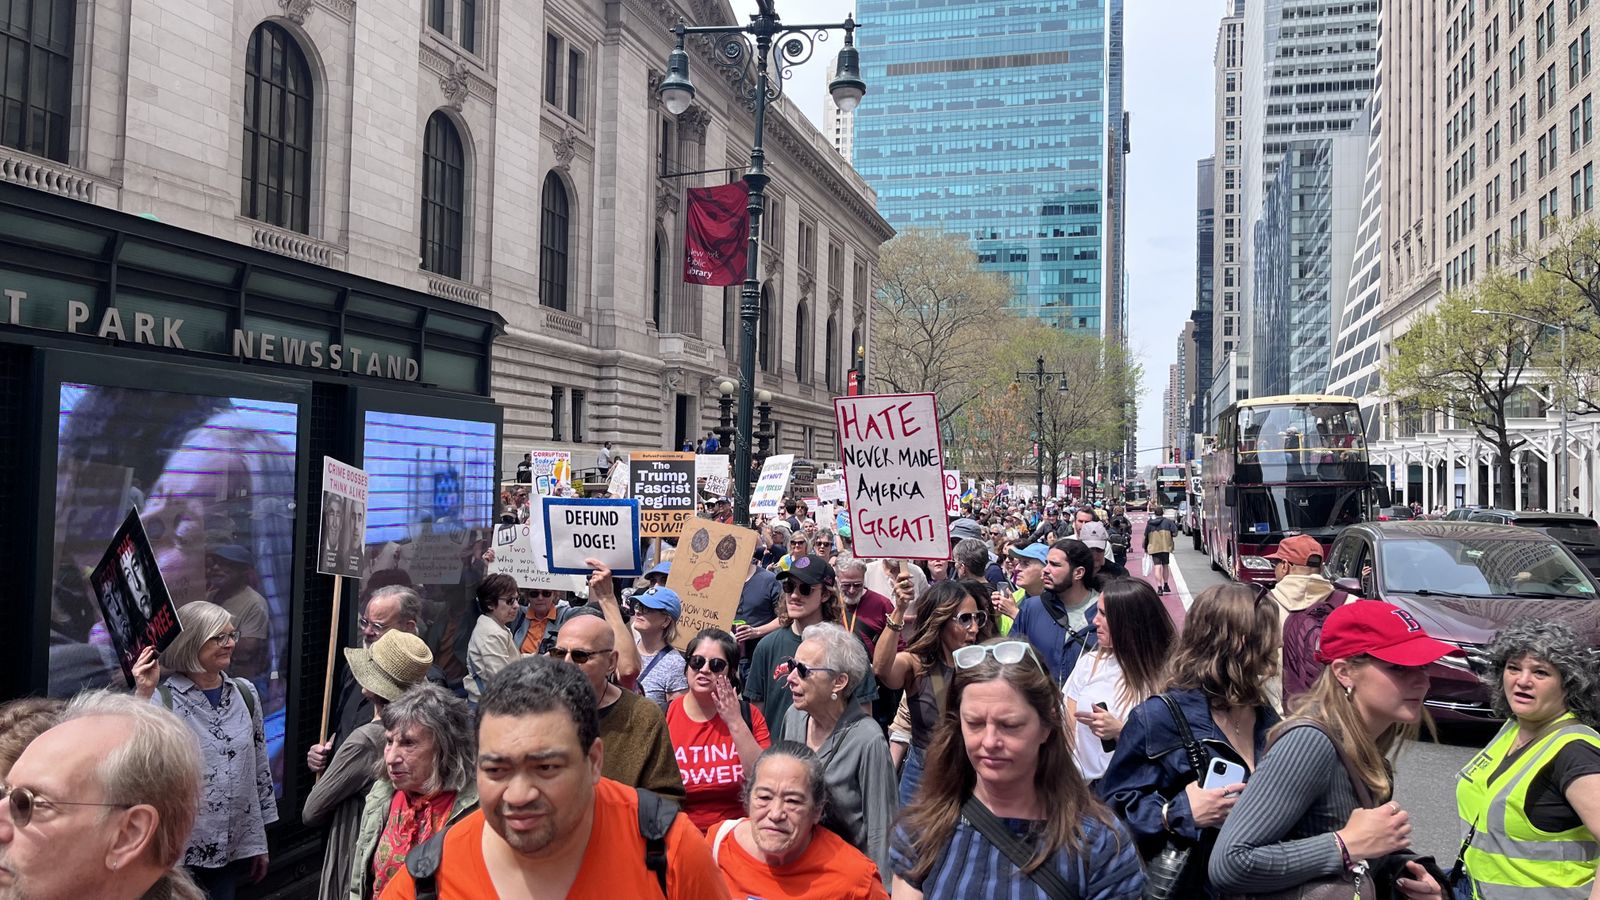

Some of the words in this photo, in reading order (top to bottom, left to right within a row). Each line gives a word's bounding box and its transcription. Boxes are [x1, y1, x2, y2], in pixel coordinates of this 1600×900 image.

[68, 300, 184, 349] PARK
[233, 328, 419, 381] NEWSSTAND
[841, 401, 921, 442] HATE
[843, 444, 894, 468] NEVER
[899, 447, 939, 468] MADE
[328, 463, 346, 479] CRIME
[346, 468, 368, 487] BOSSES
[638, 470, 688, 484] Trump
[330, 478, 347, 494] THINK
[349, 485, 365, 500] ALIKE
[635, 482, 691, 494] Fascist
[633, 494, 692, 509] Regime
[565, 510, 619, 526] DEFUND
[640, 513, 669, 521] UST
[640, 523, 684, 533] NOW!!
[858, 508, 934, 548] GREAT!
[573, 533, 616, 550] DOGE!
[681, 601, 700, 615] NOW
[702, 608, 719, 620] YOUR
[1390, 608, 1421, 632] B
[146, 604, 174, 644] SPREE
